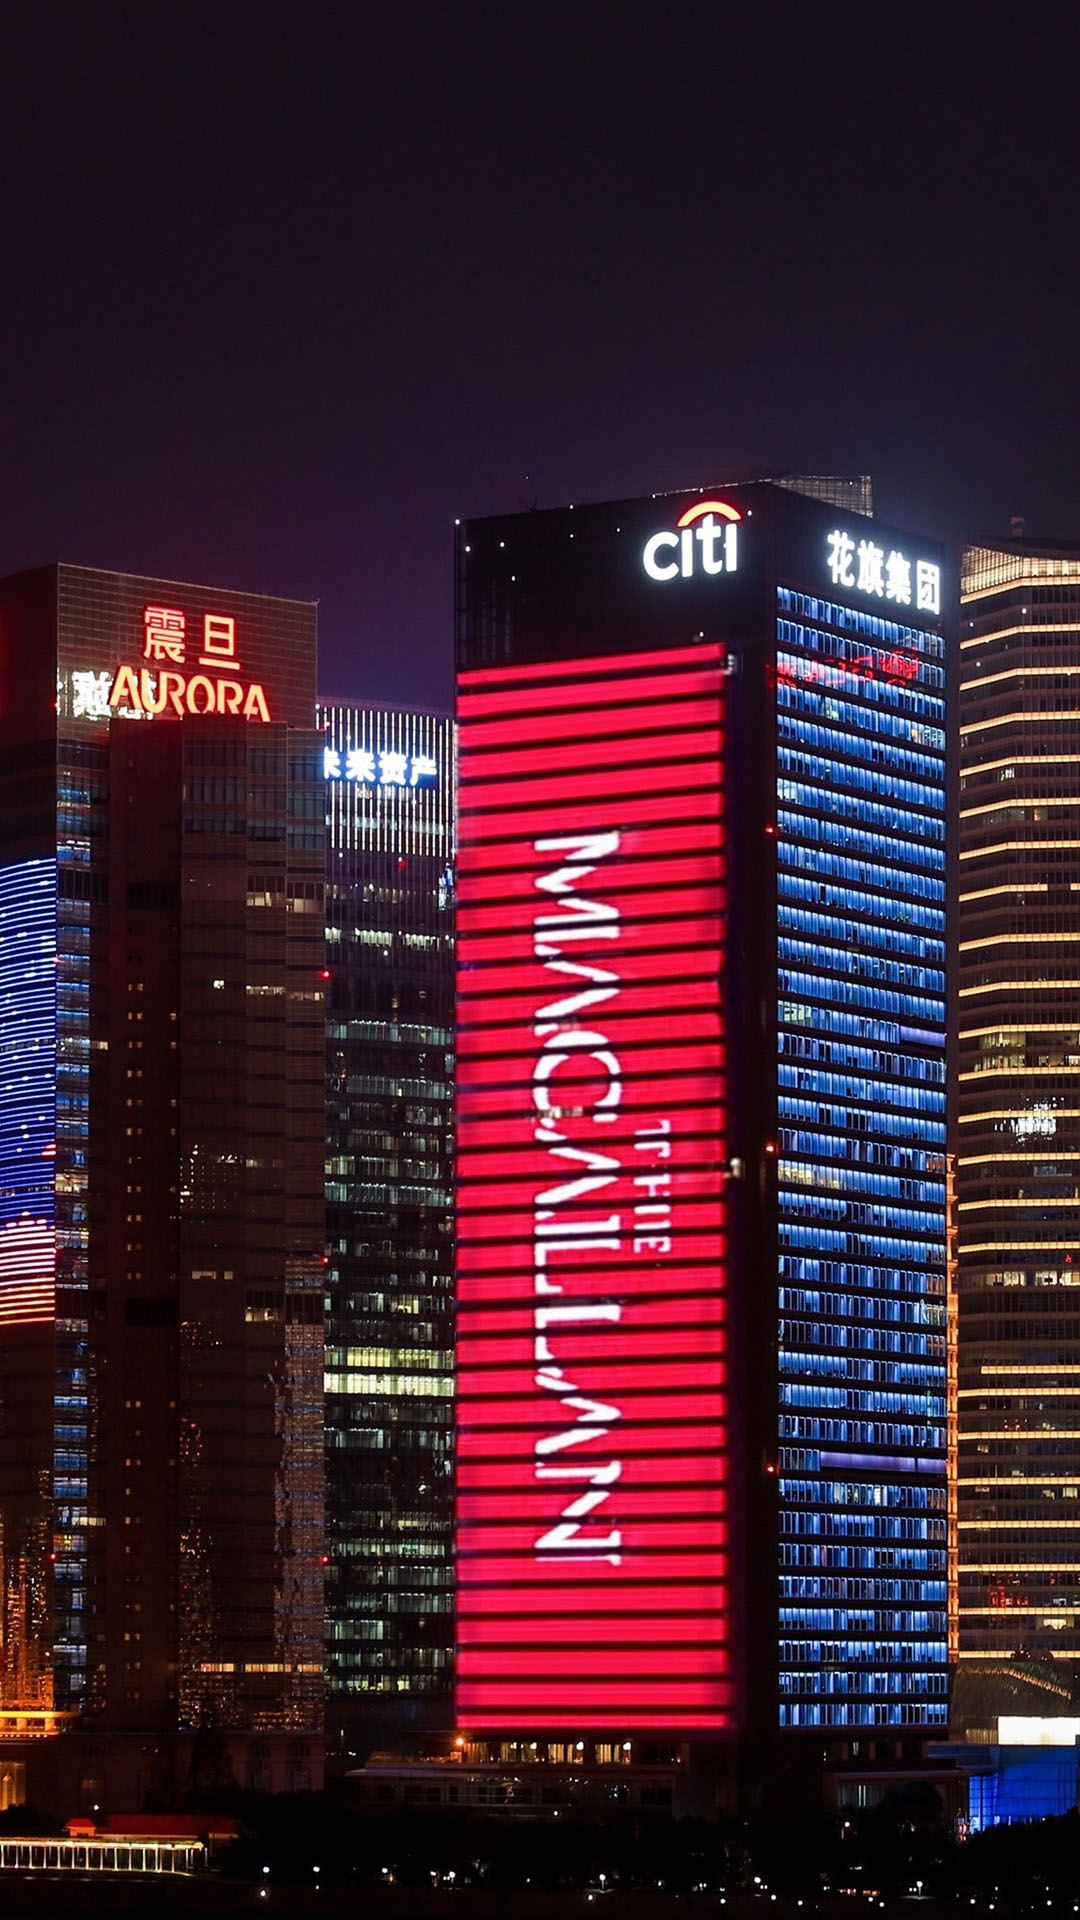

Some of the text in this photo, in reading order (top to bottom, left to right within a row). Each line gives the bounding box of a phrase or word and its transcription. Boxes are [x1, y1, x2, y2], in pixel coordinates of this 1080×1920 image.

[643, 513, 738, 581] citi
[827, 529, 941, 616] 花旗集团
[143, 605, 241, 671] 震旦
[109, 665, 271, 723] AURORA
[533, 830, 622, 1566] MACALLAN
[633, 1119, 671, 1253] THE
